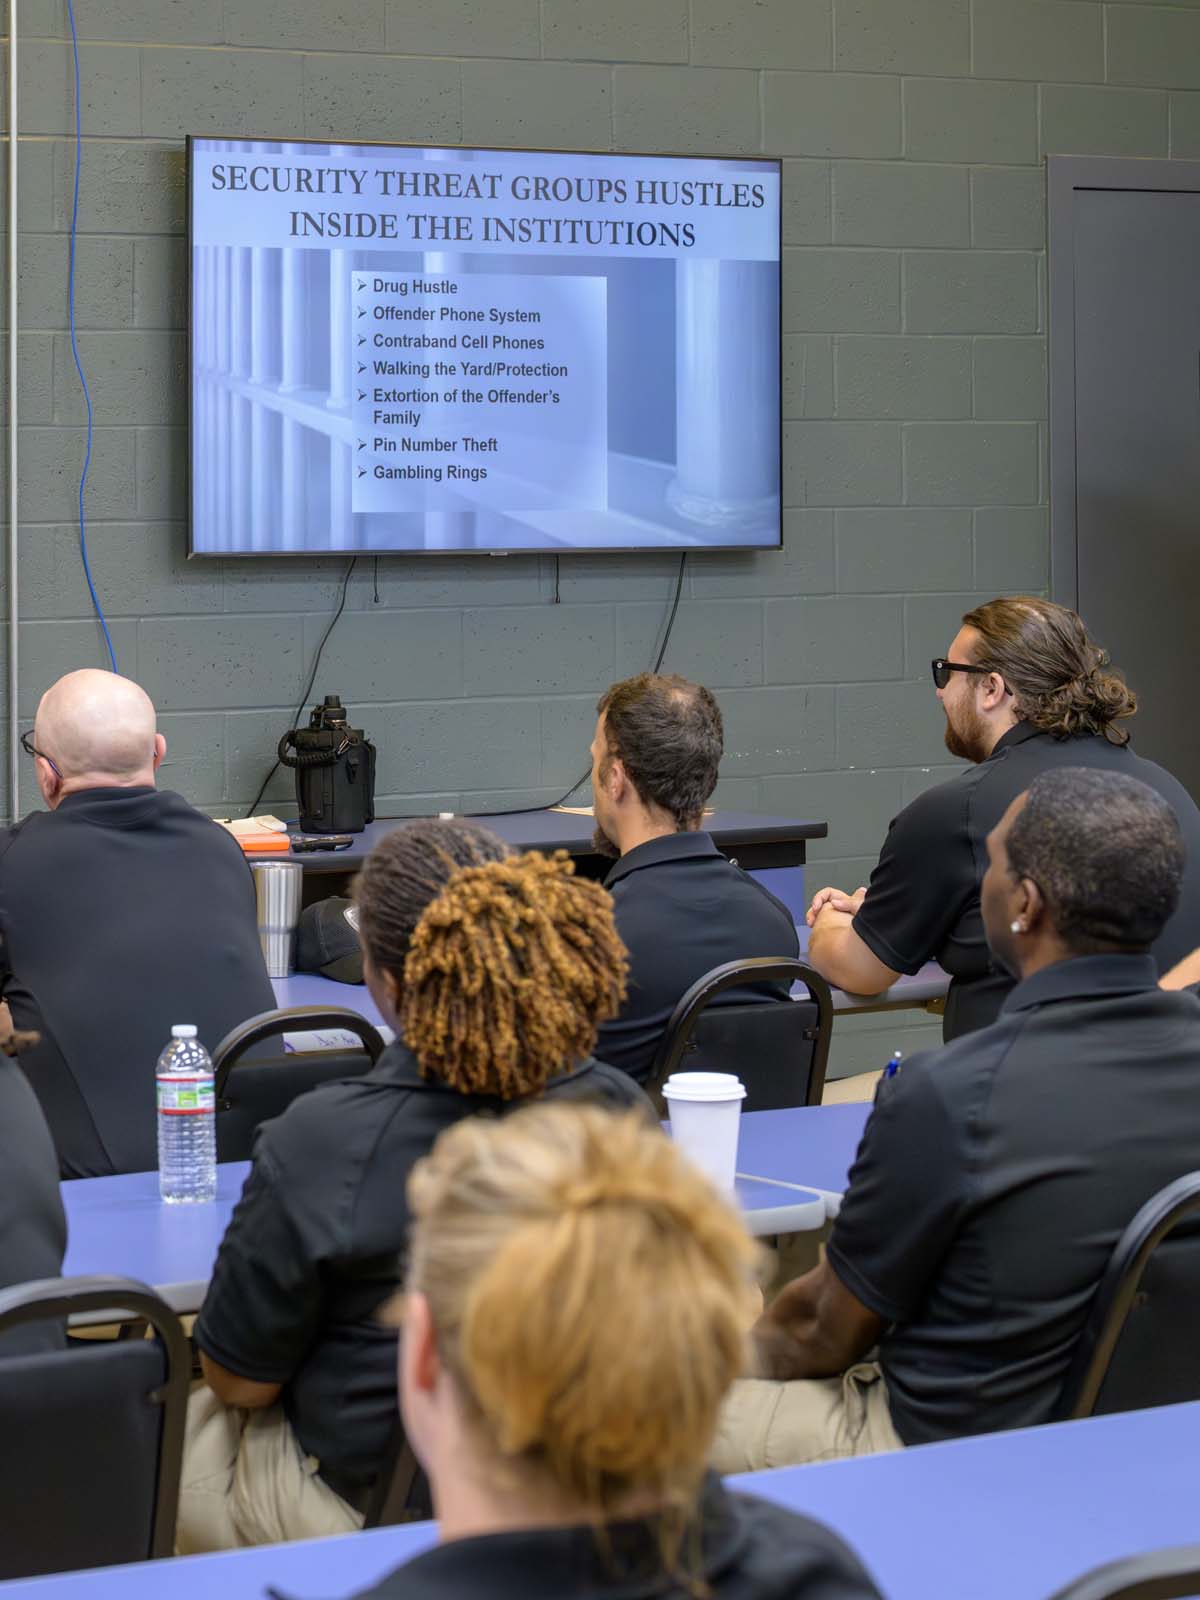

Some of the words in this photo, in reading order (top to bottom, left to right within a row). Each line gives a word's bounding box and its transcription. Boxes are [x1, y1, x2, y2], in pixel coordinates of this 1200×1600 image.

[211, 164, 369, 195] SECURITY
[375, 168, 503, 199] THREAT
[511, 175, 627, 204] GROUPS
[635, 180, 765, 208] HUSTLES
[289, 211, 399, 239] INSIDE
[406, 213, 473, 241] THE
[481, 217, 696, 247] INSTITUTIONS
[373, 278, 408, 296] Drug
[412, 279, 458, 294] Hustle
[373, 306, 436, 321] Offender
[440, 307, 485, 322] Phone
[489, 308, 541, 325] System
[373, 333, 457, 348] Contraband
[461, 334, 488, 349] Cell
[492, 335, 545, 350] Phones
[373, 360, 430, 378] Walking
[434, 361, 457, 375] the
[460, 361, 568, 377] Yard/Protection
[373, 388, 439, 403] Extortion
[443, 388, 458, 403] of
[461, 389, 484, 403] the
[373, 410, 421, 427] Family
[374, 437, 397, 451] Pin
[401, 437, 457, 452] Number
[461, 438, 498, 452] Theft
[373, 465, 443, 482] Gambling
[447, 465, 487, 482] Rings
